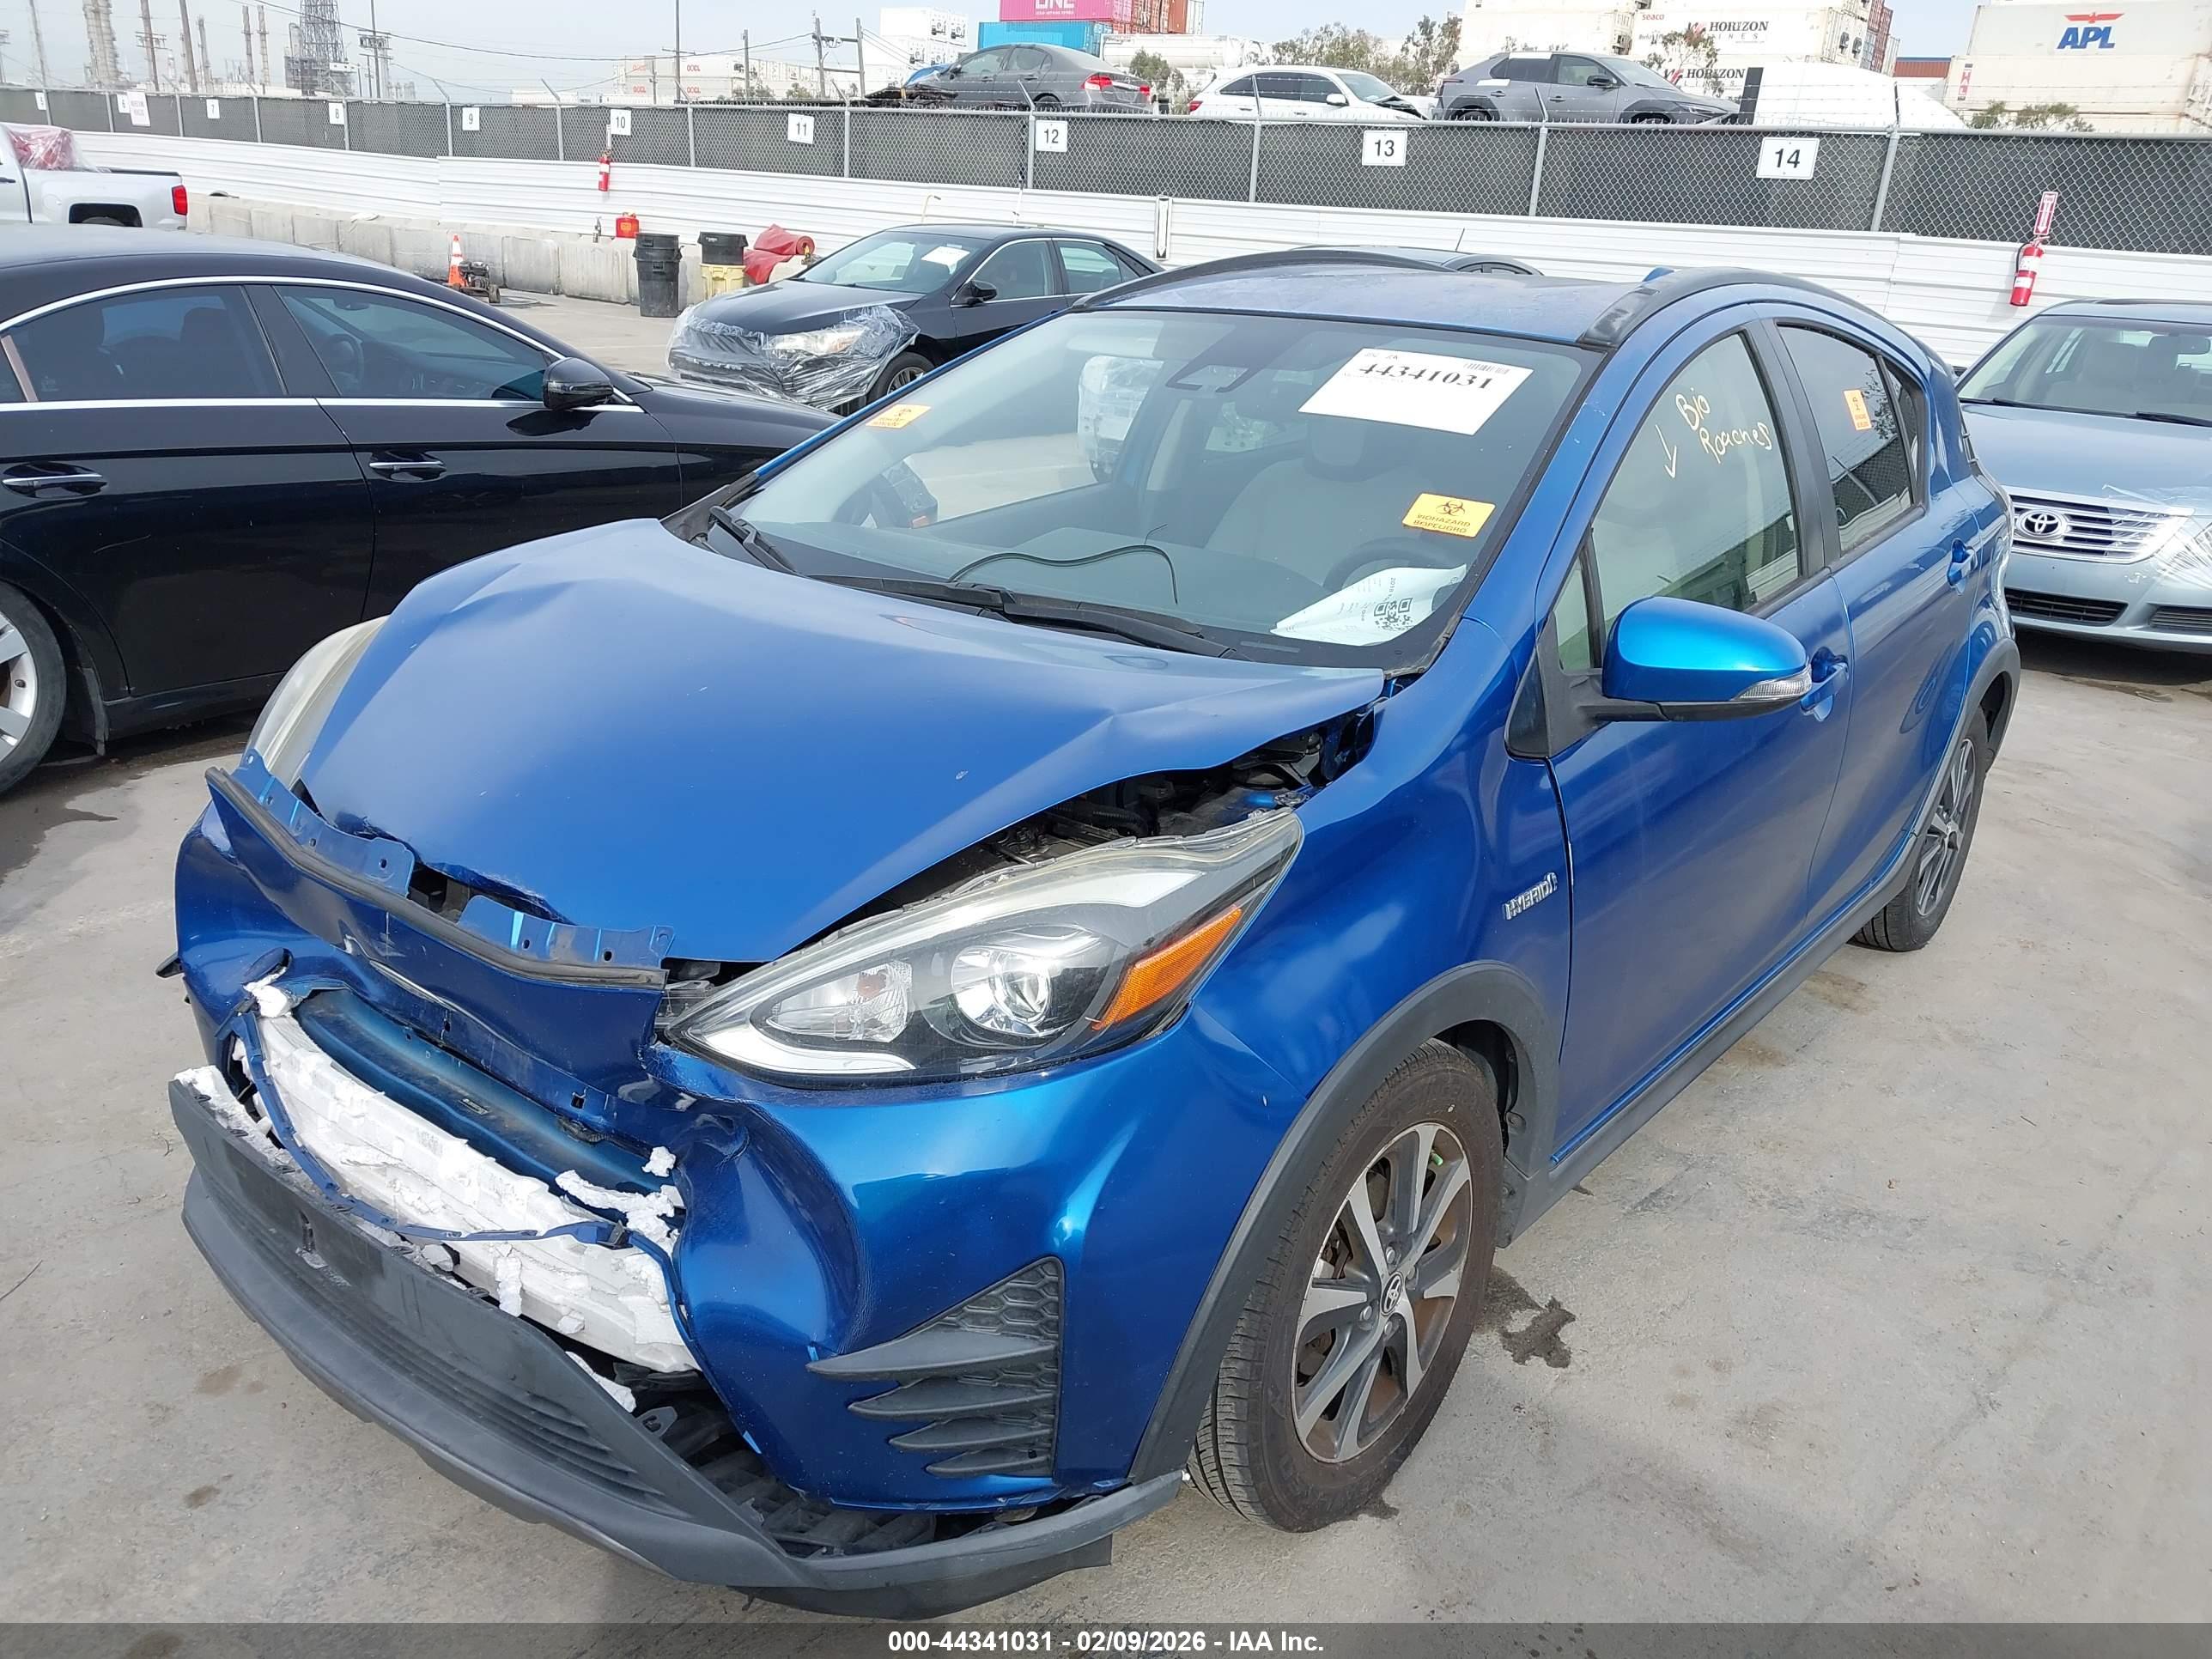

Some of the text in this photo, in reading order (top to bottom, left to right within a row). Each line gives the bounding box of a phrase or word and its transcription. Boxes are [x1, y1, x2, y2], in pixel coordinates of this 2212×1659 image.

[1709, 21, 1769, 32] HORIZON
[2057, 26, 2116, 49] APL
[335, 108, 340, 119] 8
[468, 112, 474, 125] 9
[615, 116, 626, 129] 10
[796, 121, 807, 137] 11
[1043, 128, 1059, 144] 12
[1374, 139, 1395, 157] 13
[1775, 148, 1801, 168] 14
[1359, 363, 1493, 390] 44341031
[1675, 387, 1711, 431] Bio
[1503, 880, 1550, 921] HYBRID
